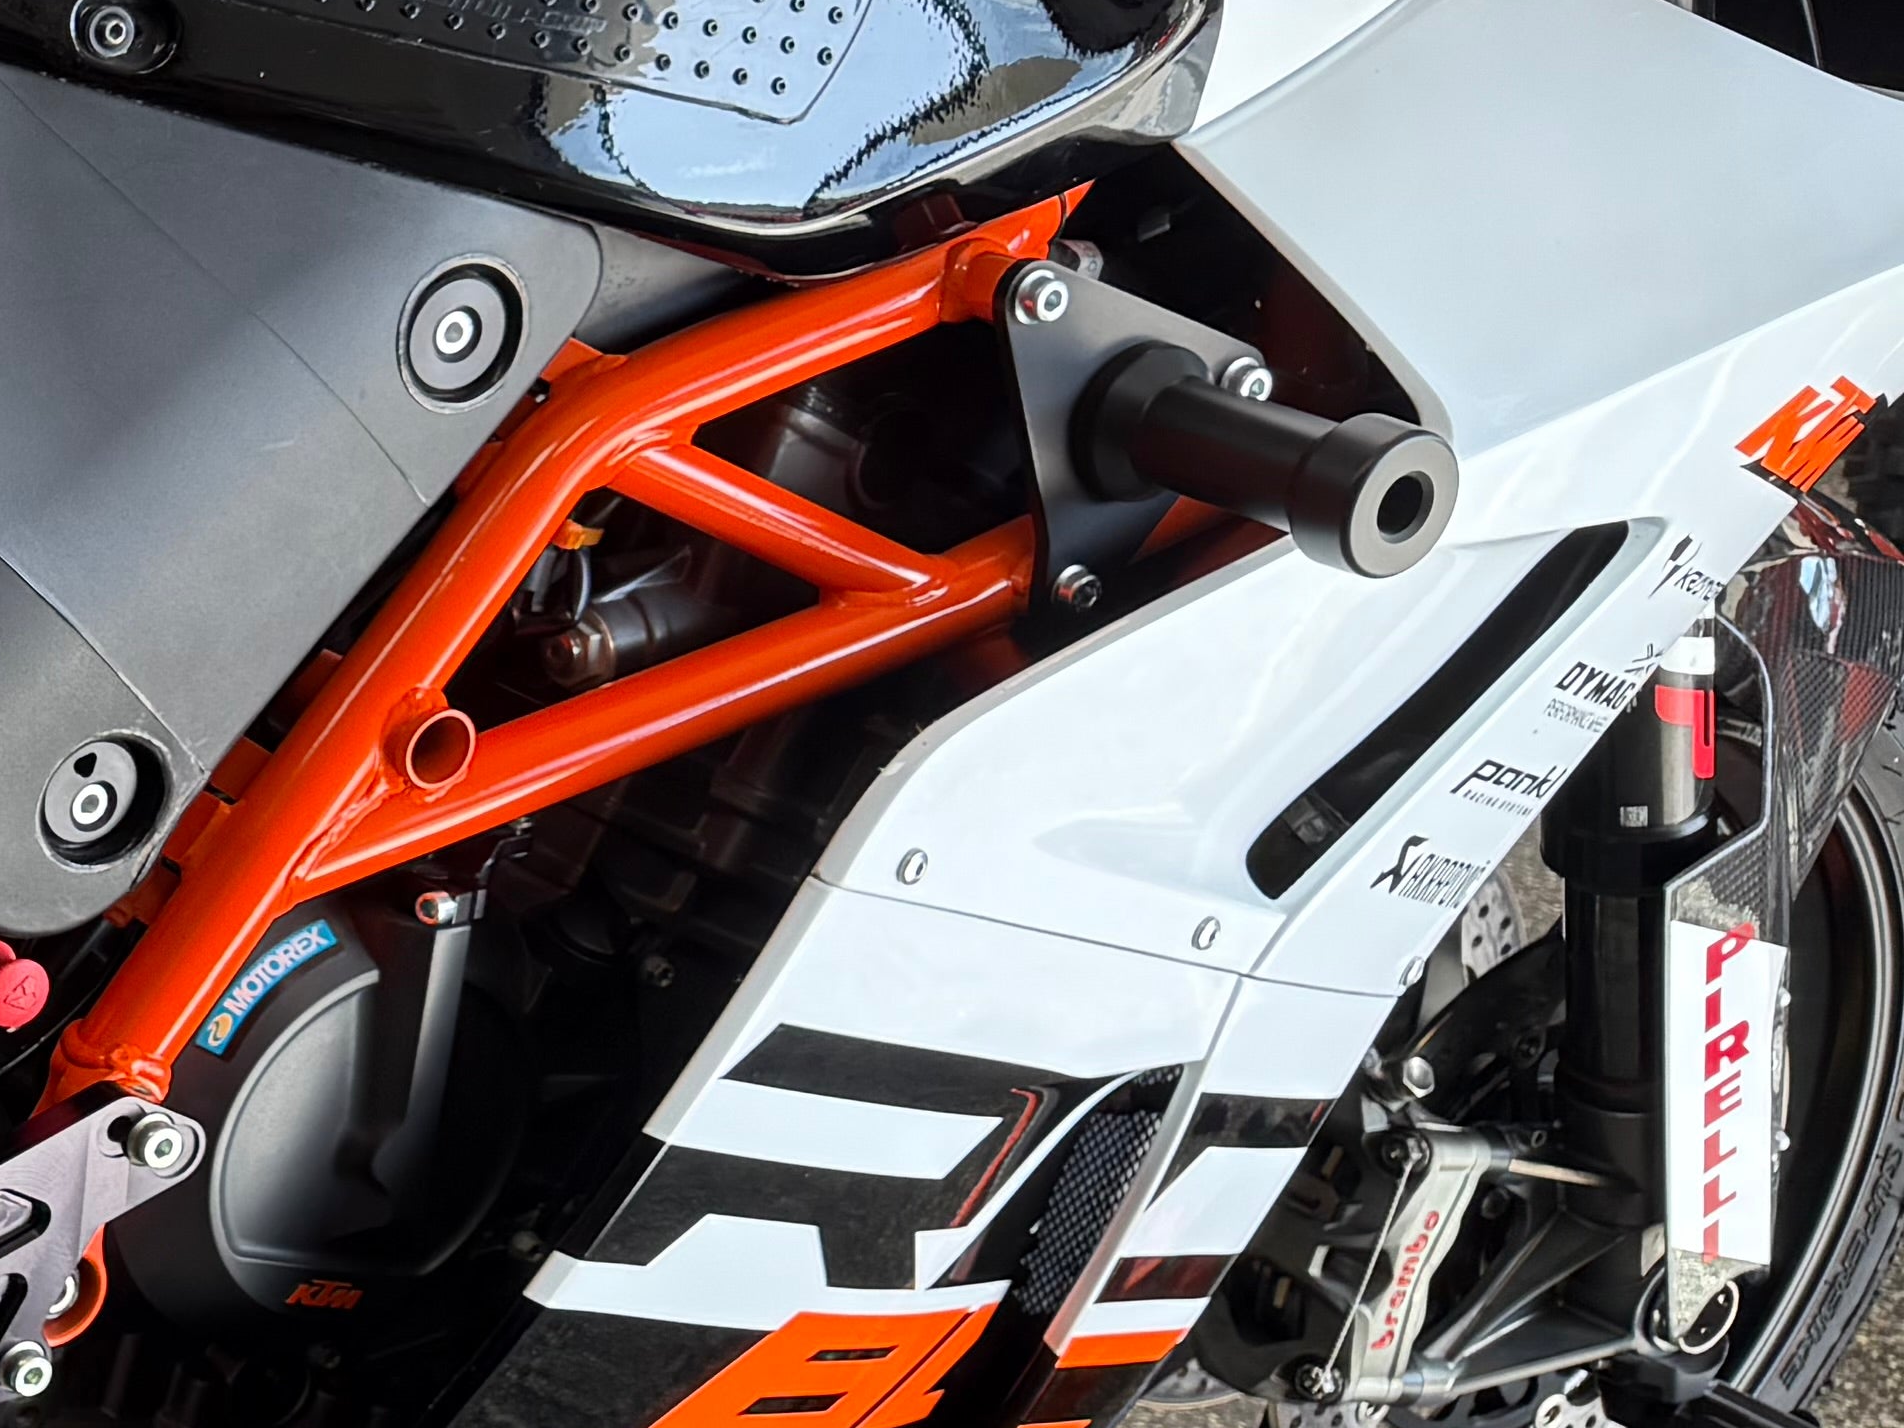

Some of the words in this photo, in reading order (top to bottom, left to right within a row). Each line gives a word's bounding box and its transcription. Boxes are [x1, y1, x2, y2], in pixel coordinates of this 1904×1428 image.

[1734, 375, 1878, 493] KTM
[1554, 661, 1636, 710] DYMAG
[1449, 758, 1568, 799] pankl
[223, 925, 329, 1017] MOTOREX
[1703, 922, 1756, 1266] PIRELLI
[285, 1280, 364, 1310] KTM
[1370, 1210, 1440, 1350] brembo
